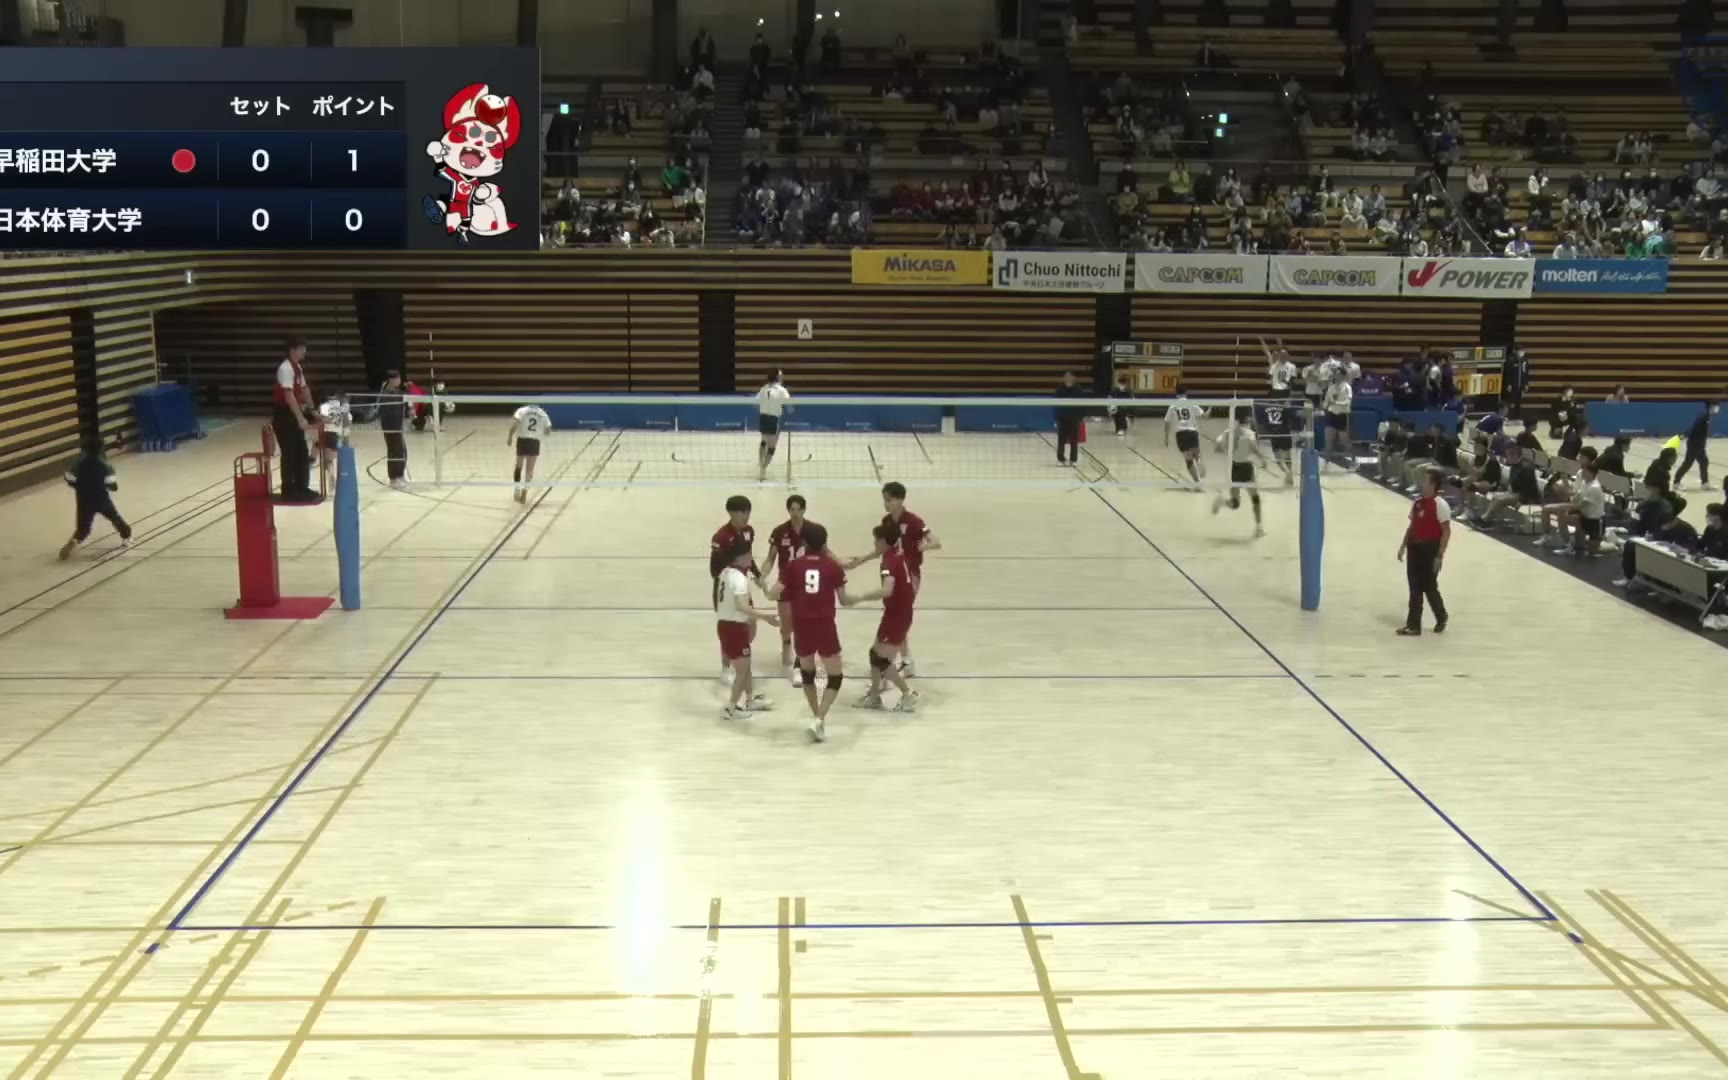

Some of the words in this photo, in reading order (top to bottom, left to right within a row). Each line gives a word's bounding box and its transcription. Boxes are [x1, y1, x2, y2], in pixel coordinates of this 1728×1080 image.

[1023, 262, 1060, 276] Chuo
[1064, 263, 1121, 278] Nittochi
[1158, 266, 1243, 284] CAPCOM
[1294, 268, 1377, 287] CAPCOM
[1541, 268, 1598, 282] molten
[800, 323, 810, 335] A
[527, 418, 538, 432] 2
[1267, 411, 1283, 425] 12
[804, 568, 820, 594] 9
